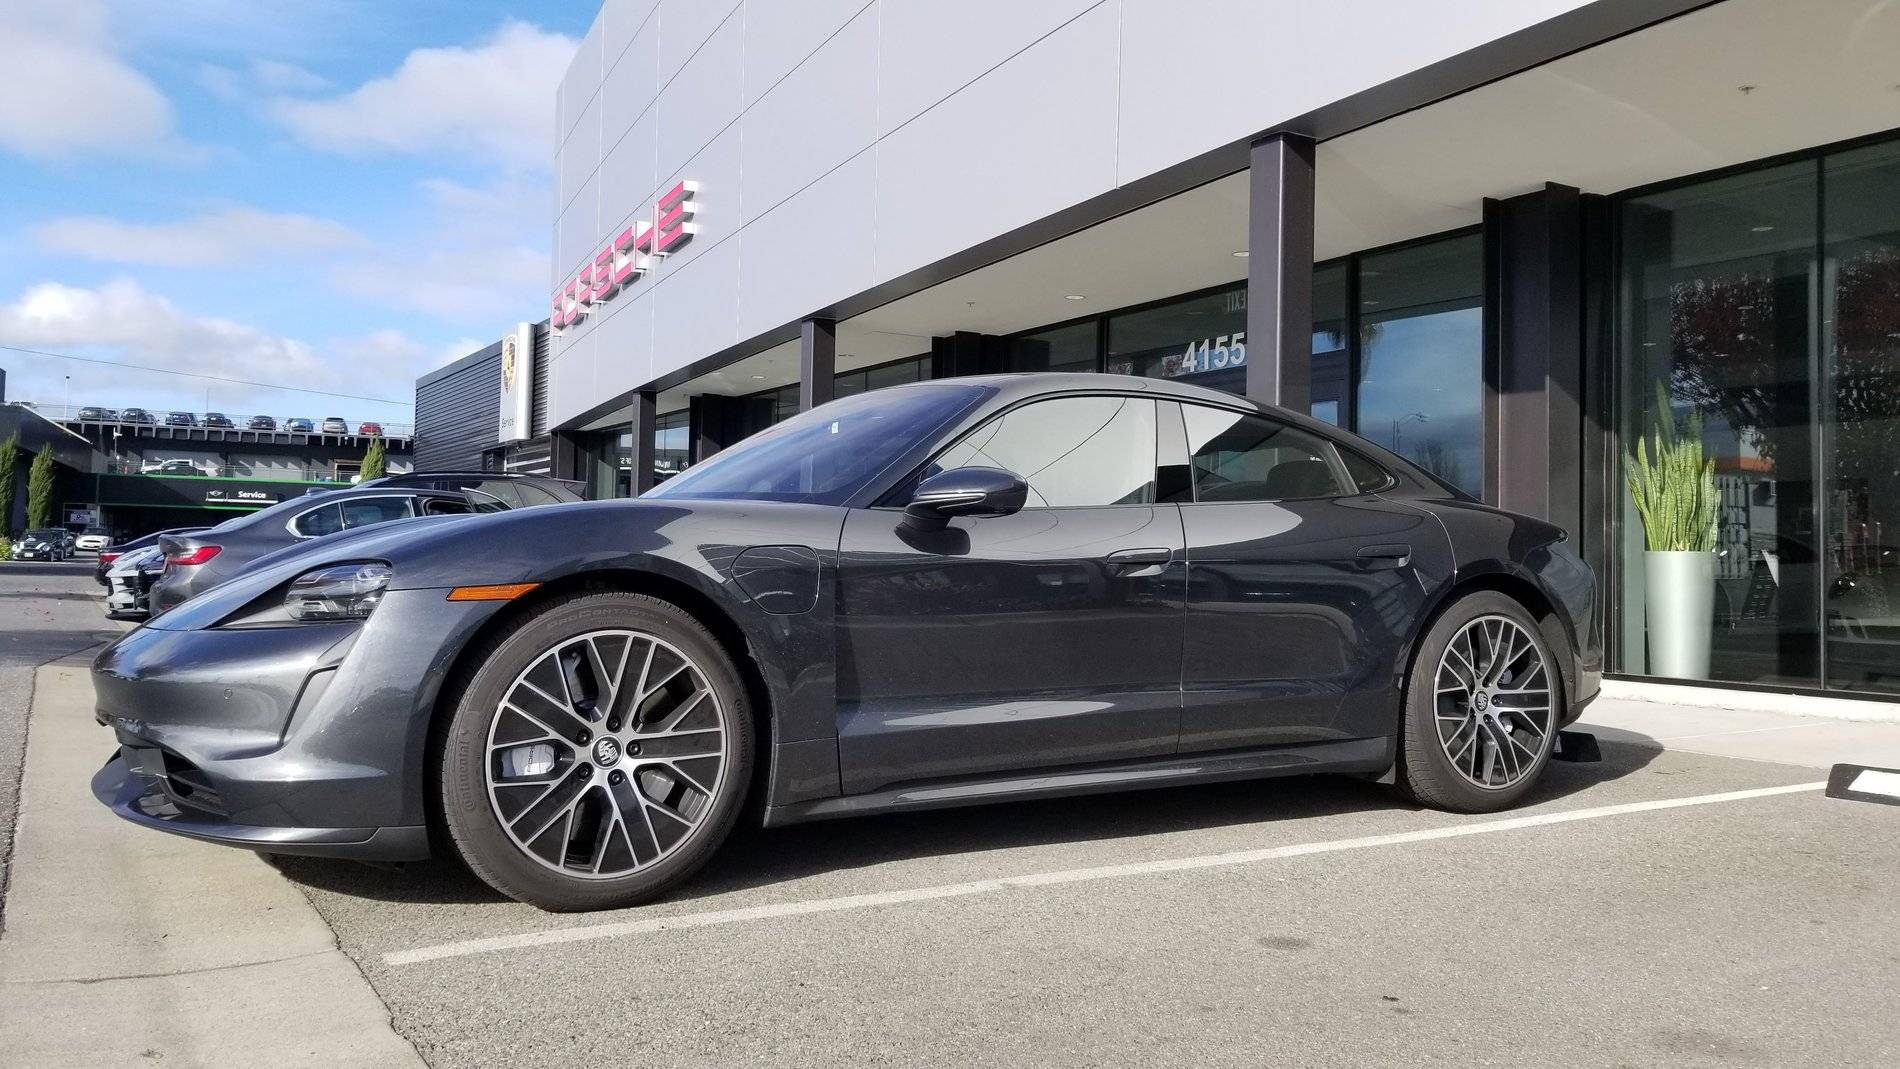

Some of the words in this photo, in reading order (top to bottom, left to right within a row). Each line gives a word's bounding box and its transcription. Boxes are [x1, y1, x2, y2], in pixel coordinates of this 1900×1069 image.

[1182, 332, 1246, 372] 4155
[237, 490, 267, 500] Service
[458, 739, 476, 813] Continental
